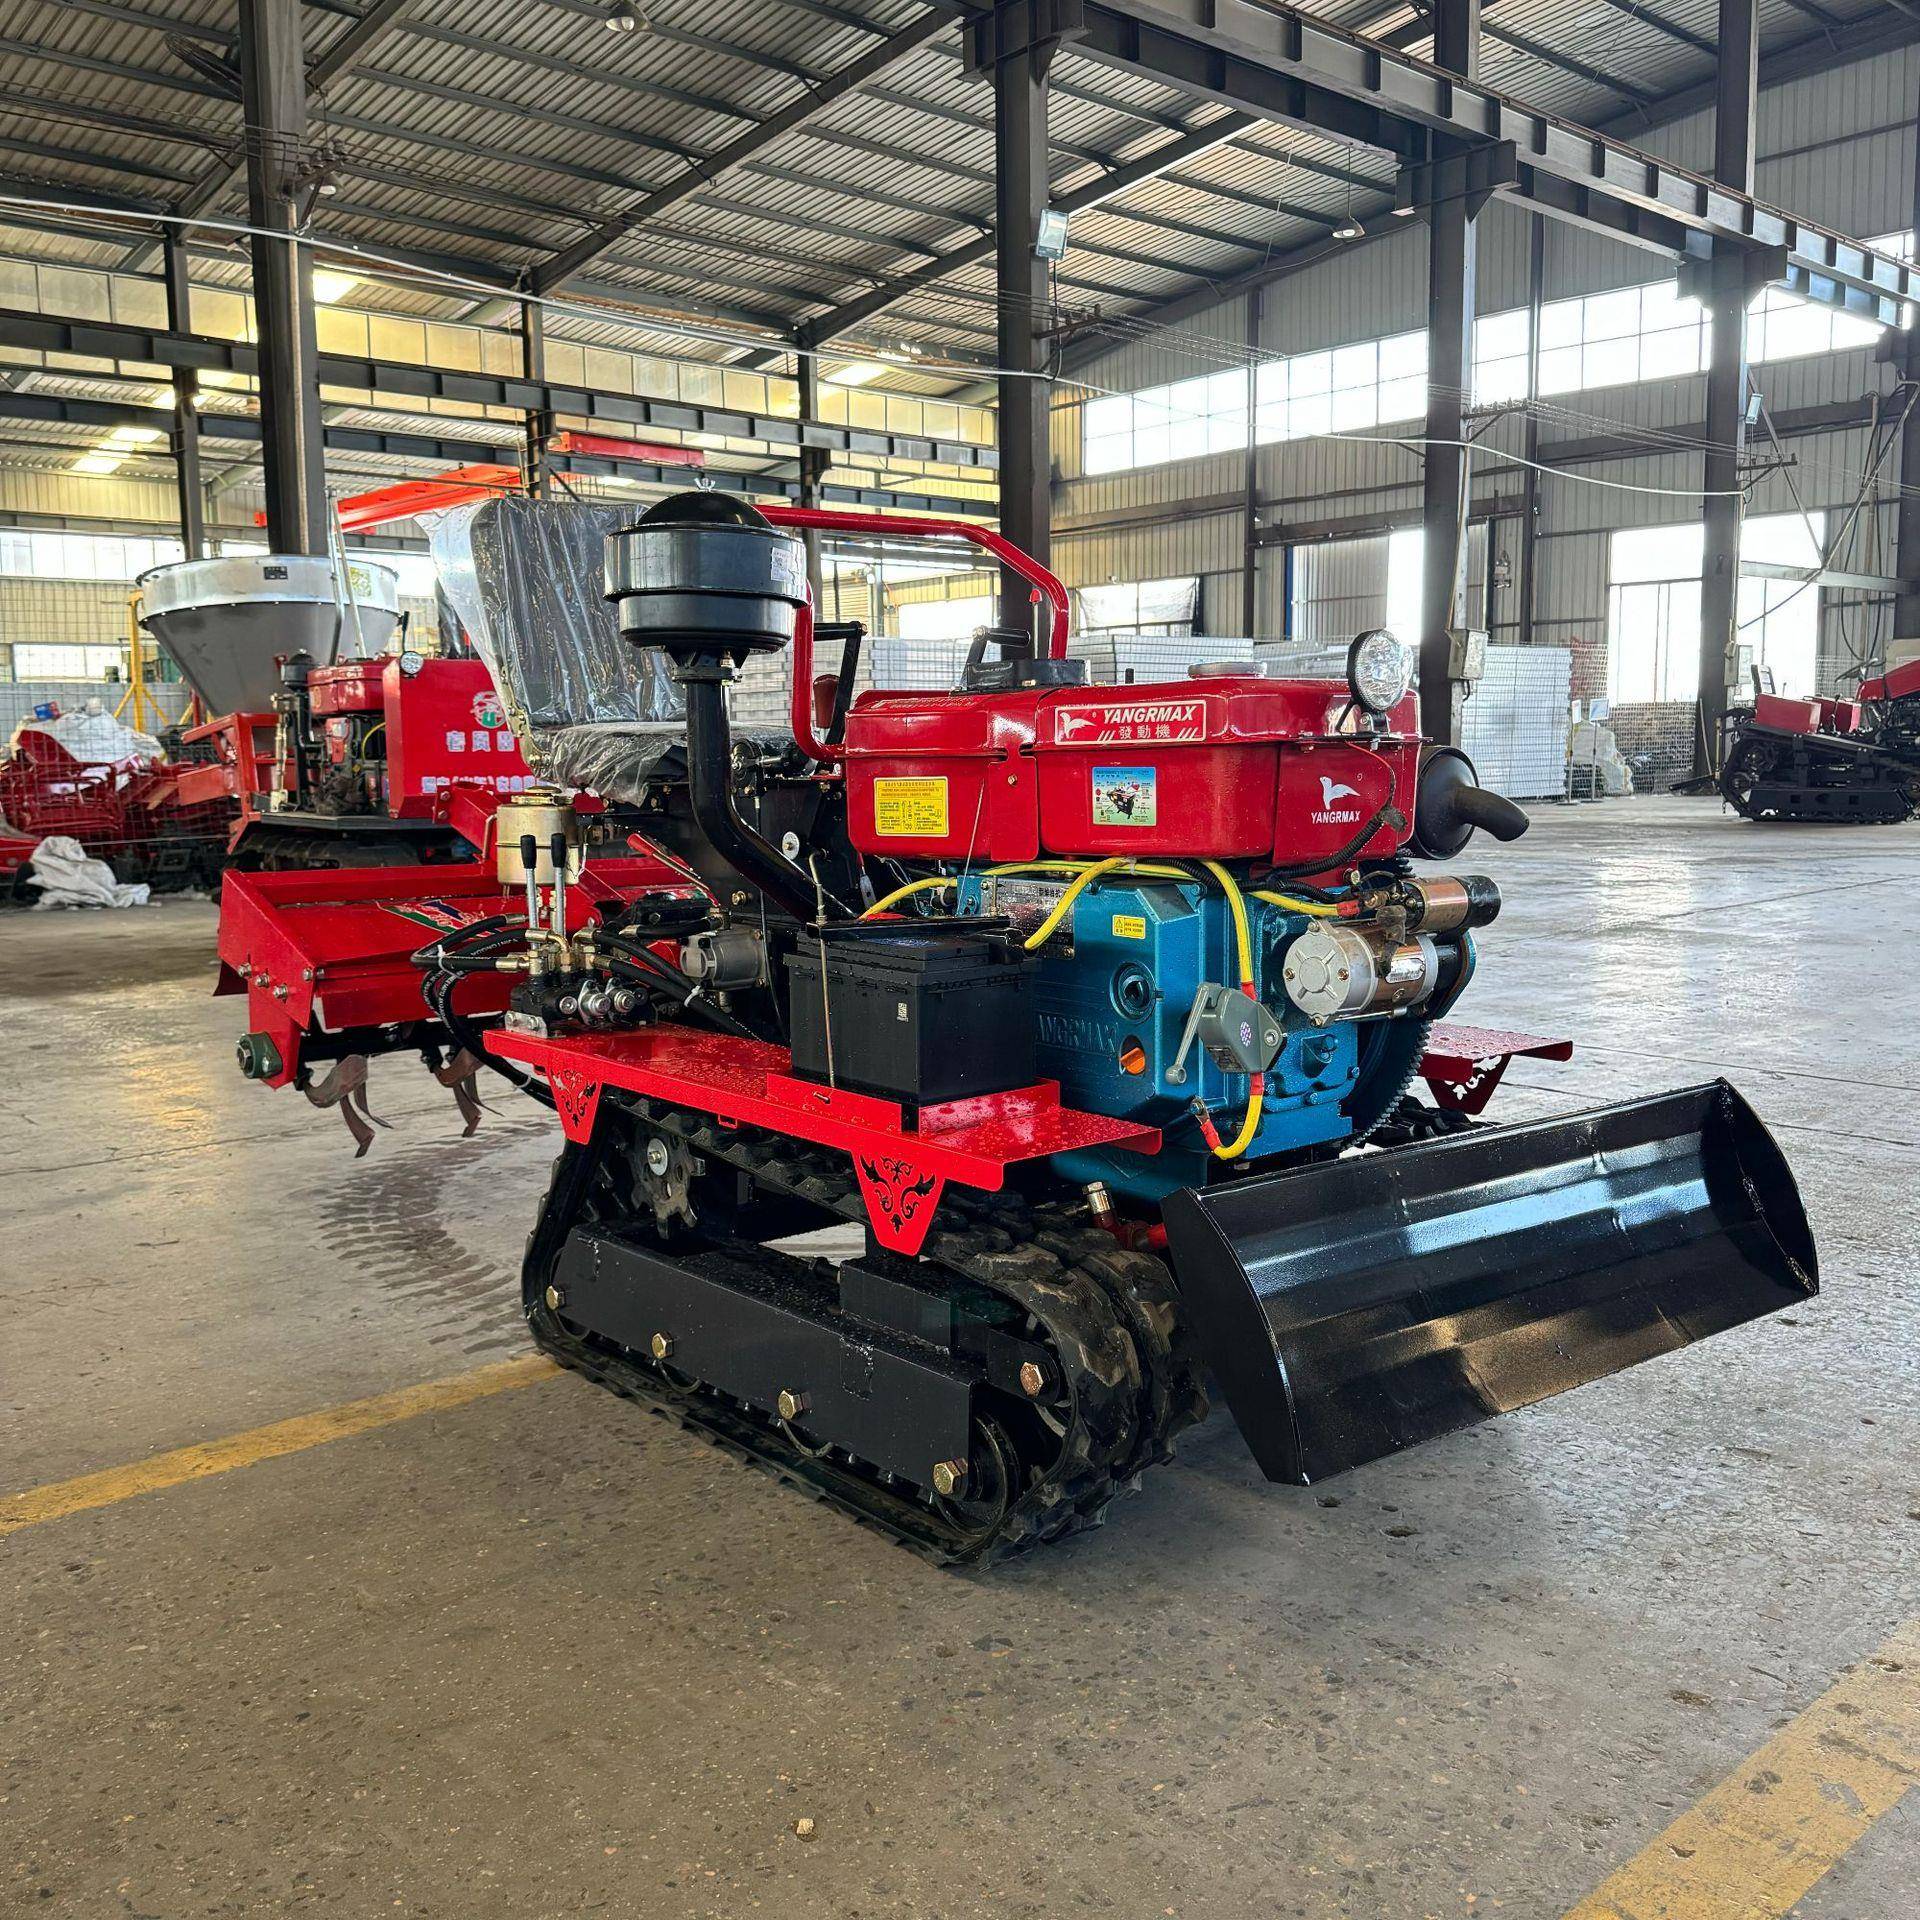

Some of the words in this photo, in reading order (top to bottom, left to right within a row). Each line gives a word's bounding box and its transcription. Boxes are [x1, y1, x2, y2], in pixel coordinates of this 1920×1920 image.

[1103, 705, 1197, 724] YANGRMAX
[1118, 724, 1171, 740] 發動機
[1311, 811, 1361, 824] YANGRMAX
